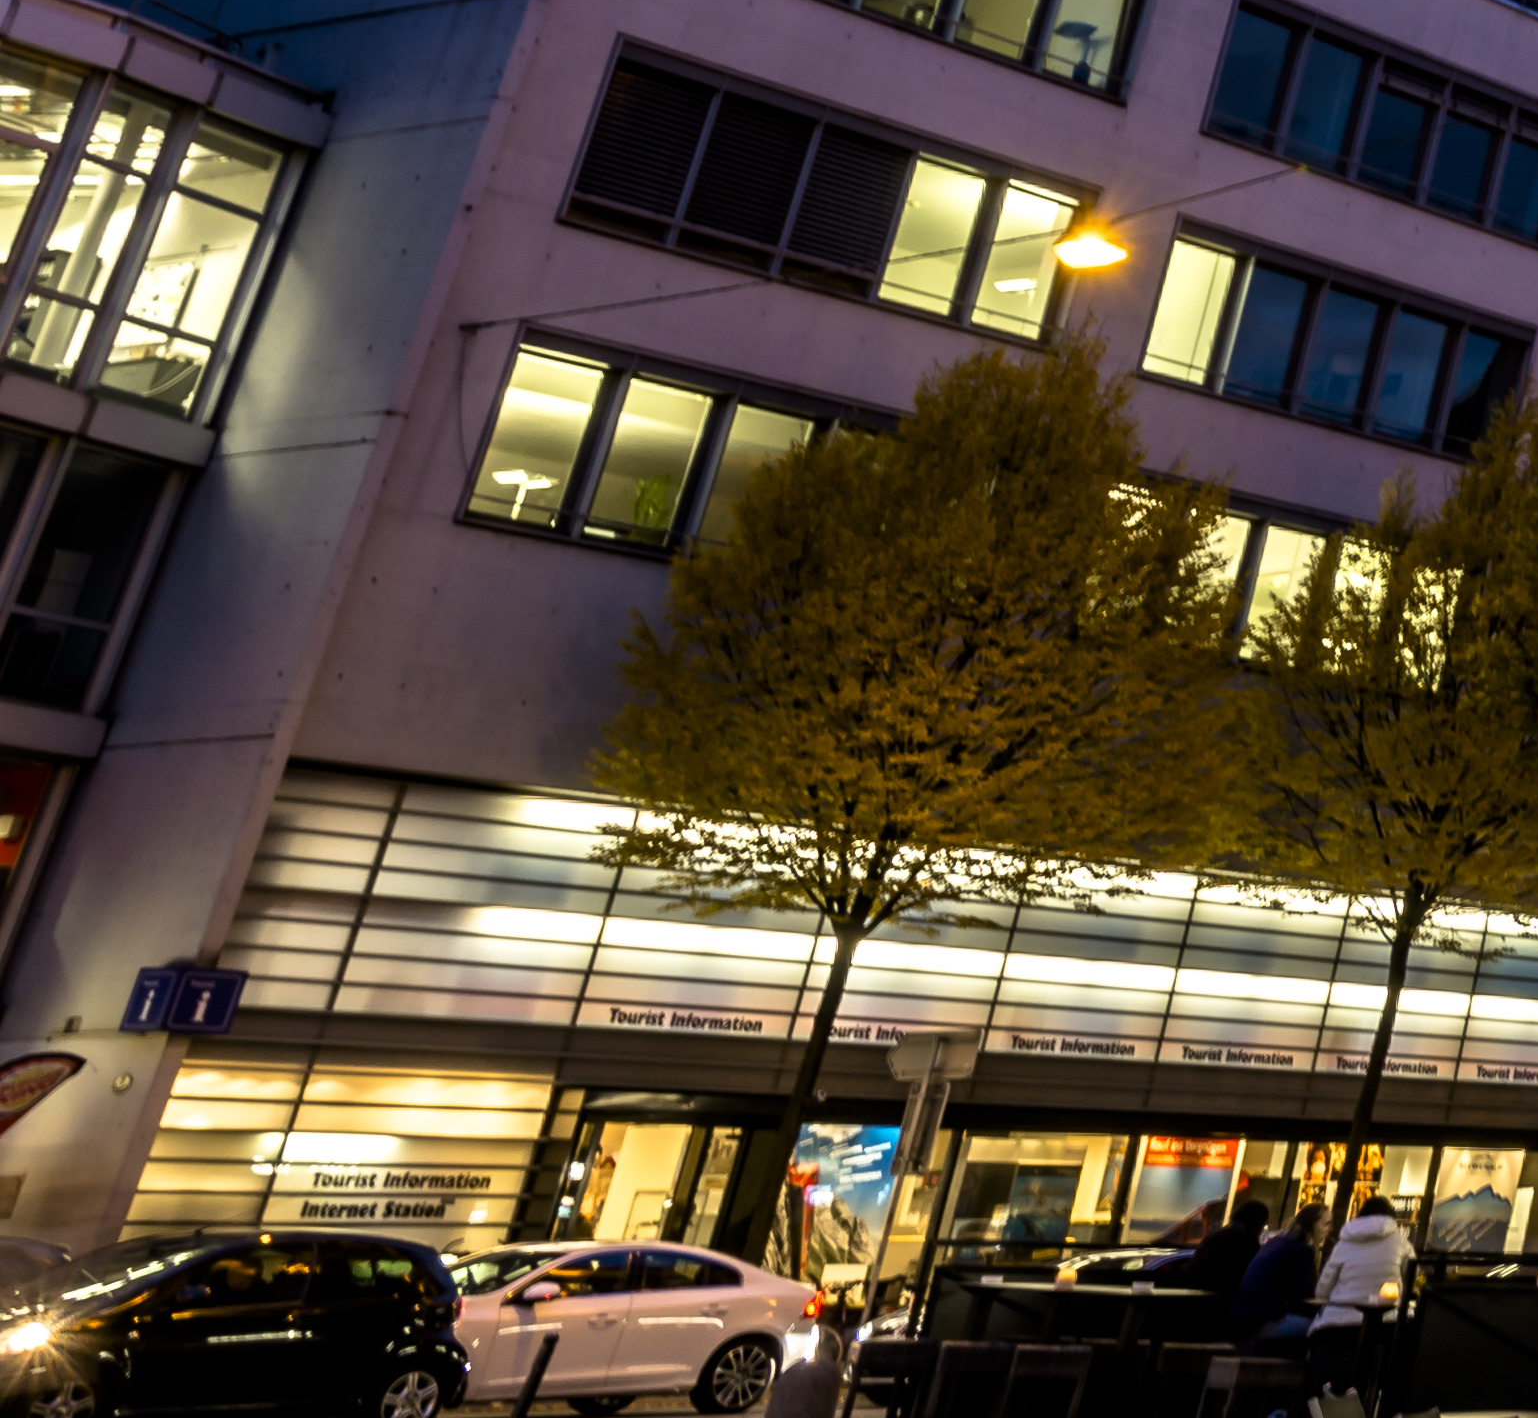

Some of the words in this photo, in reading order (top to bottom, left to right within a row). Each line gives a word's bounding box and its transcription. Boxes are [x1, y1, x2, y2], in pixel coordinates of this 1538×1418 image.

[609, 1006, 665, 1027] Tourist
[670, 1010, 763, 1033] Information
[829, 1021, 872, 1041] ourist
[1011, 1034, 1057, 1052] Tourist
[1060, 1036, 1136, 1056] Information
[1182, 1044, 1223, 1062] Tourist
[1225, 1047, 1294, 1067] Information
[312, 1171, 378, 1190] Tourist
[383, 1170, 492, 1190] Information
[301, 1200, 378, 1219] Internet
[382, 1200, 446, 1220] Station
